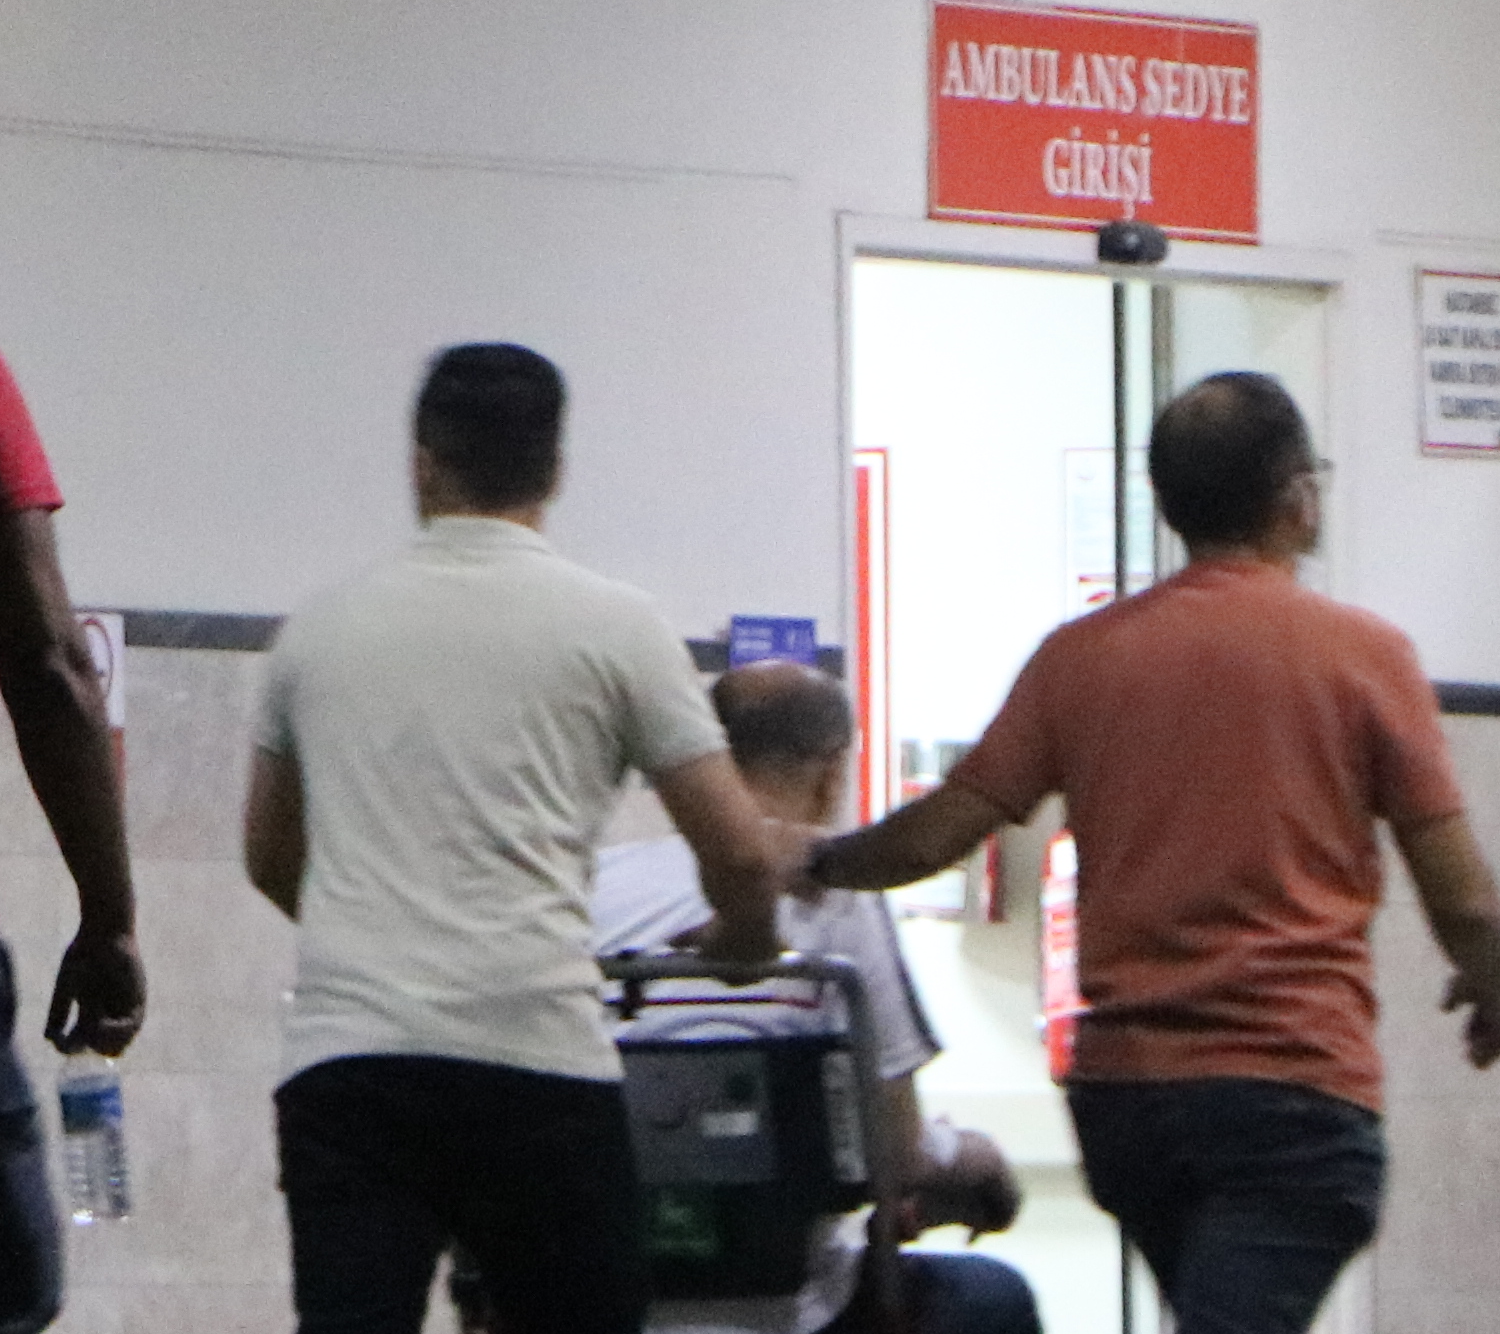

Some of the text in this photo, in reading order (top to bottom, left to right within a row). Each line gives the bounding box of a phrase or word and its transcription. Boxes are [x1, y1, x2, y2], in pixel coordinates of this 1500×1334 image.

[940, 40, 1250, 125] AMBULANS SEDYE
[1041, 125, 1153, 220] GİRİŞİ
